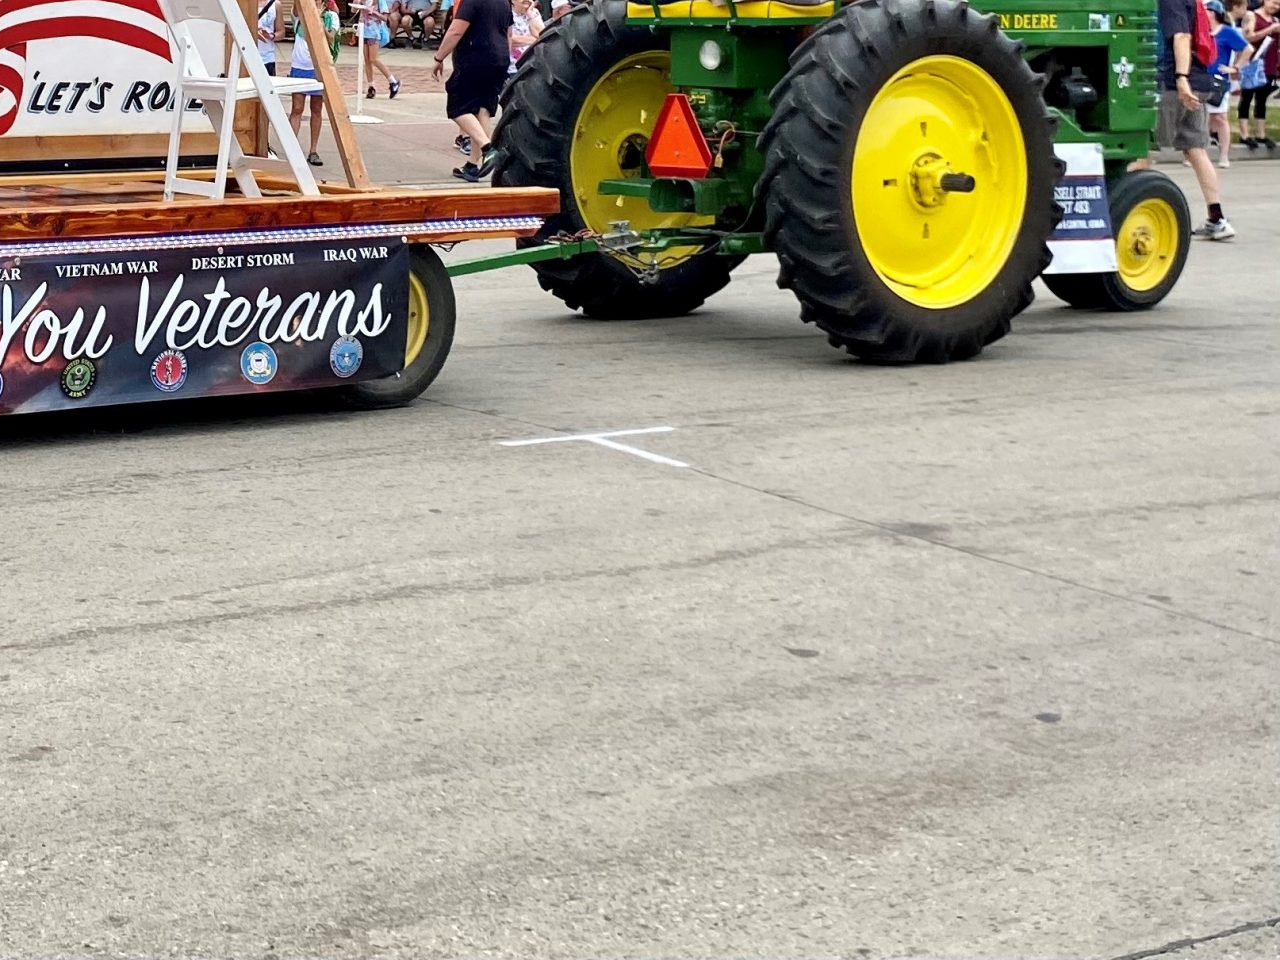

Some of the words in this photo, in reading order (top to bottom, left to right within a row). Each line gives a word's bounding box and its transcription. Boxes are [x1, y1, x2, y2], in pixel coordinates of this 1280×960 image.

[1014, 13, 1058, 29] DEERE
[56, 262, 124, 278] VIETNAM
[126, 260, 159, 274] WAR
[192, 255, 245, 271] DESERT
[247, 253, 295, 268] STORM
[324, 248, 357, 263] IRAQ
[359, 247, 388, 260] WAR
[134, 273, 391, 355] Veterans
[63, 358, 80, 375] UNITED
